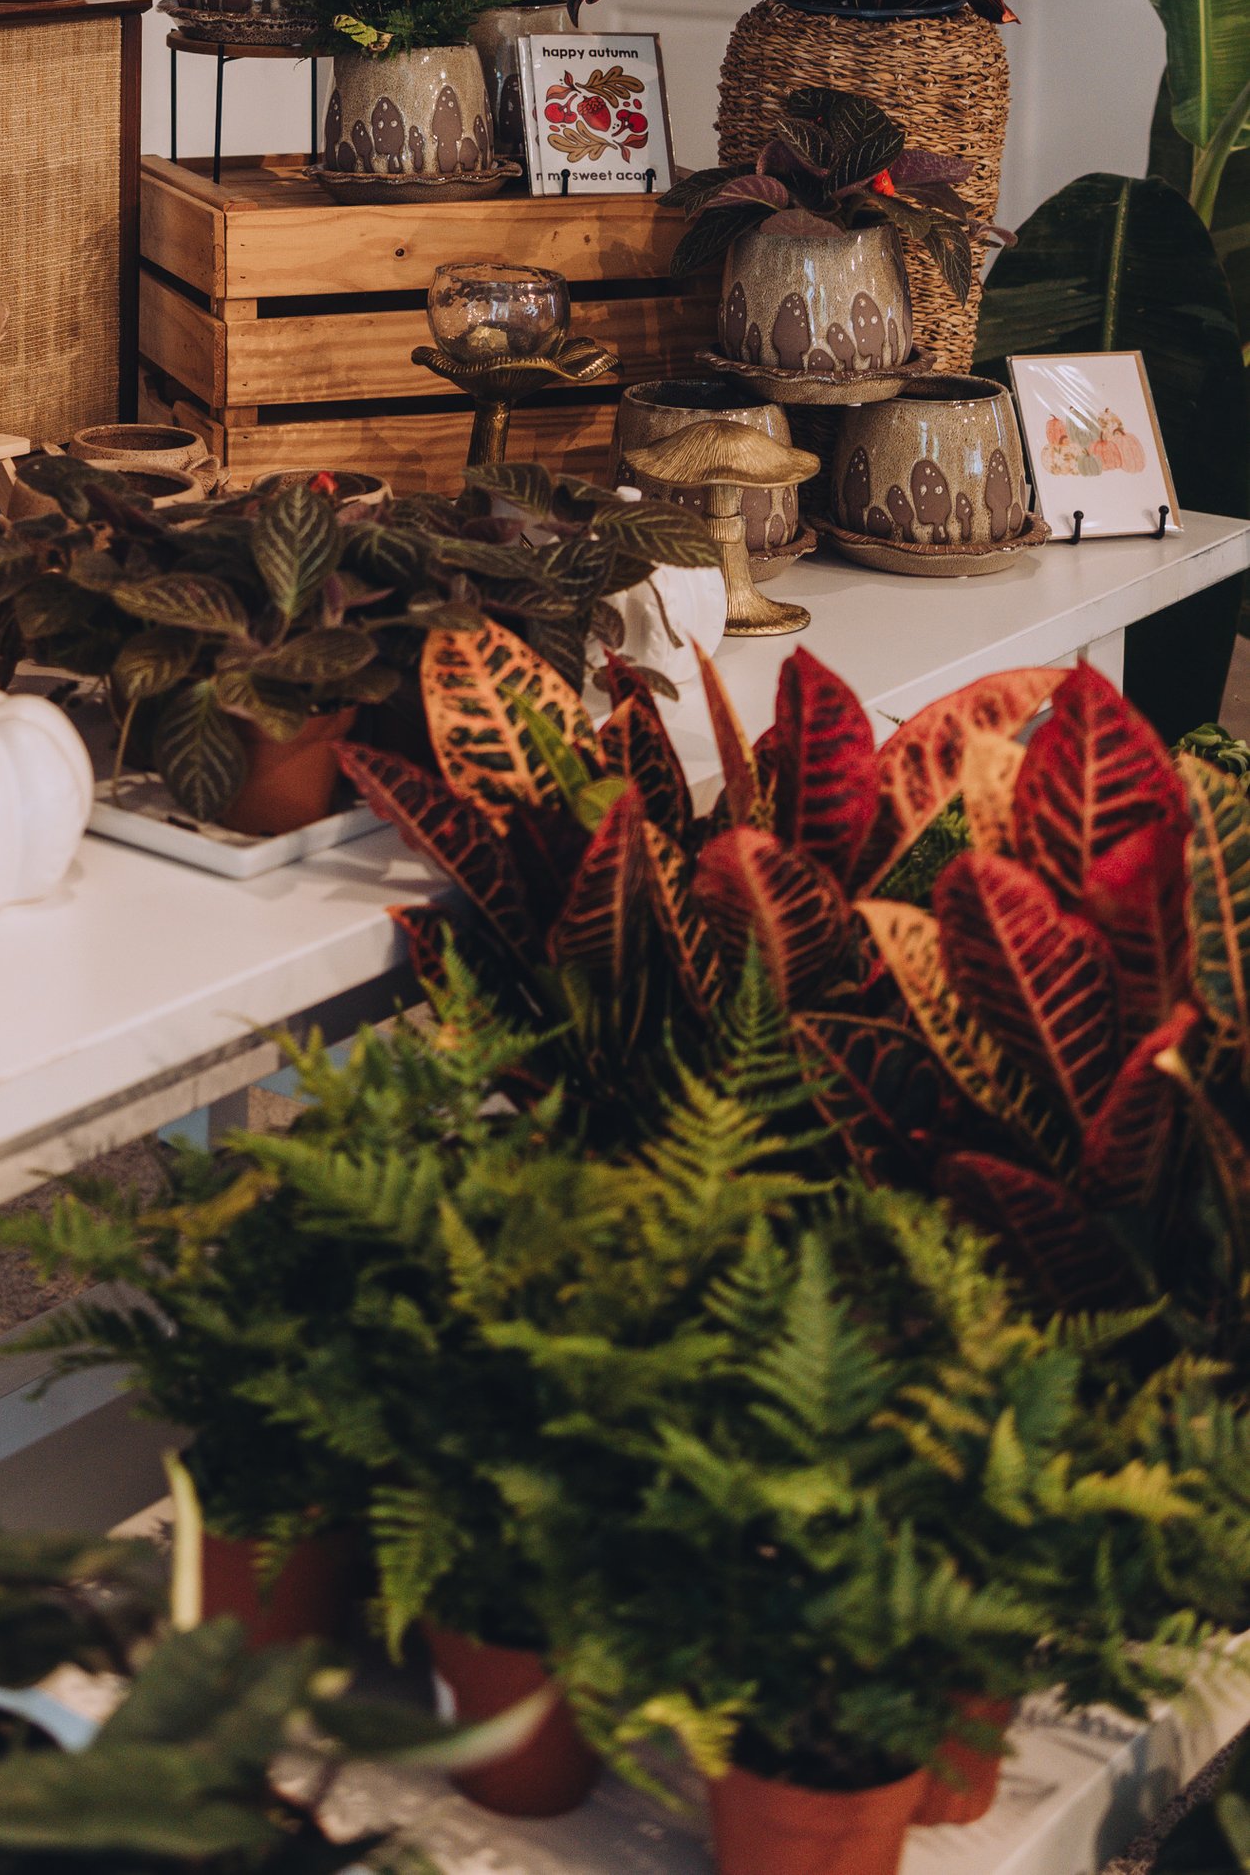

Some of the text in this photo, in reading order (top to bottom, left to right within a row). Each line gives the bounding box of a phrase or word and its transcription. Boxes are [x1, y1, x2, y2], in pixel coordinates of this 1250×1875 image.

[542, 47, 639, 59] happy autumn
[572, 170, 612, 181] sweet
